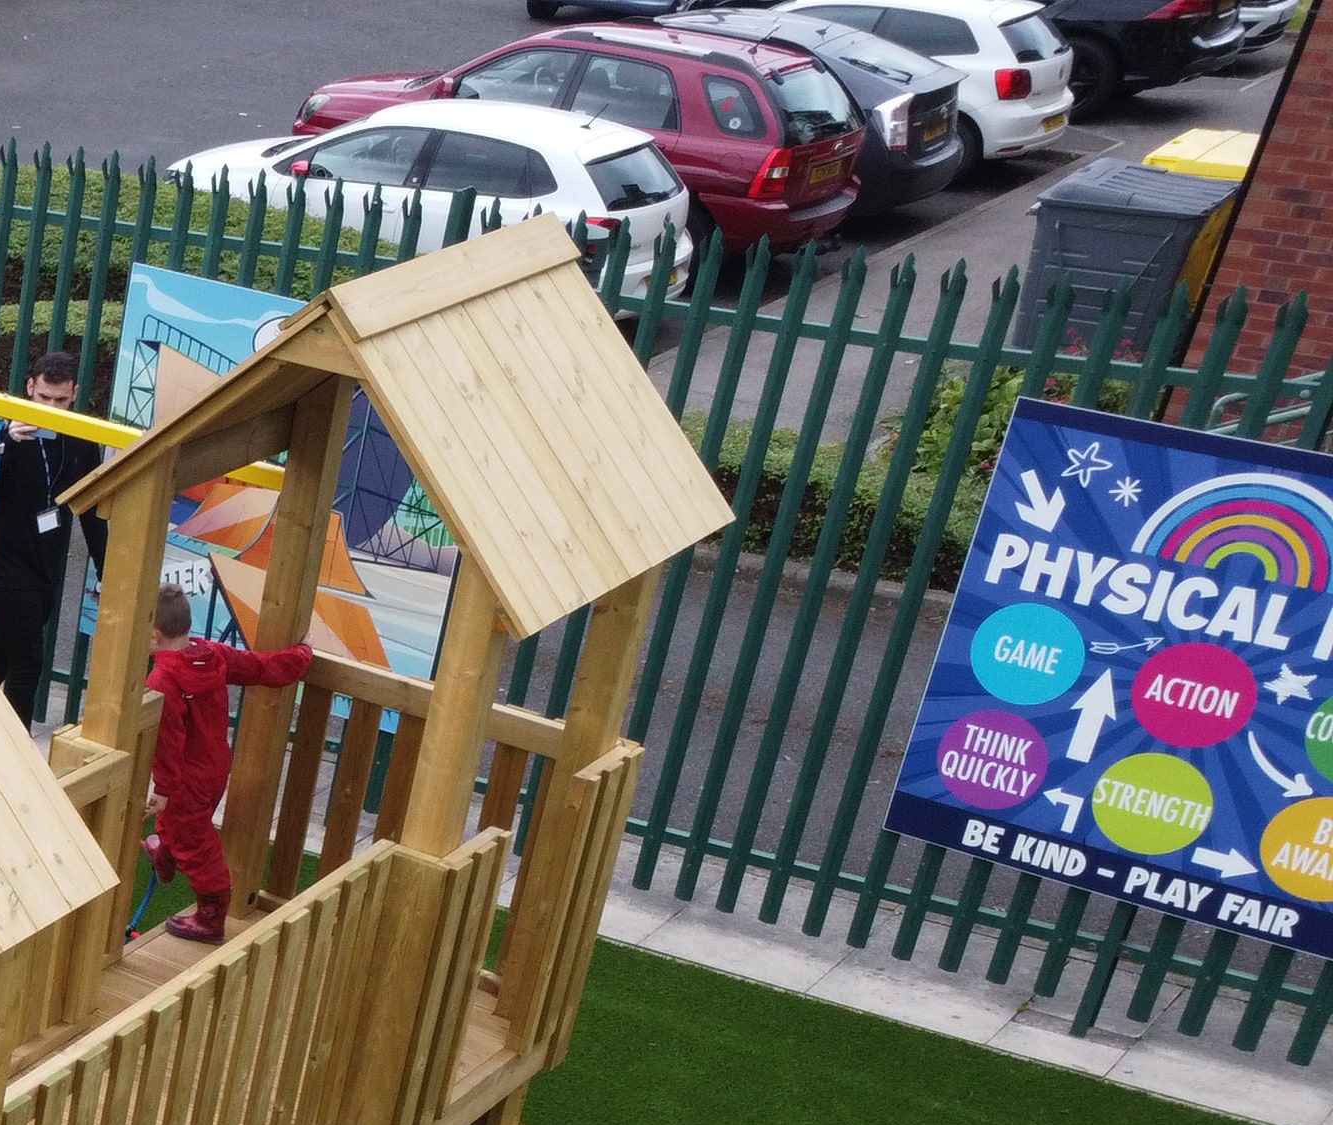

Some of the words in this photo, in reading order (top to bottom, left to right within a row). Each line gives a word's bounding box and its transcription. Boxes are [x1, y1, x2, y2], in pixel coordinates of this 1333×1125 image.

[984, 533, 1290, 651] PHYSICAL
[993, 634, 1063, 676] GAME
[1144, 674, 1240, 719] ACTION
[962, 723, 1034, 766] THINK
[940, 749, 1037, 798] QUICKLY
[1092, 776, 1214, 832] STRENGTH
[961, 818, 1005, 855] BE
[1010, 833, 1087, 878] KIND
[1122, 866, 1213, 914] PLAY
[1218, 892, 1300, 938] FAIR
[1270, 842, 1333, 881] AWA
